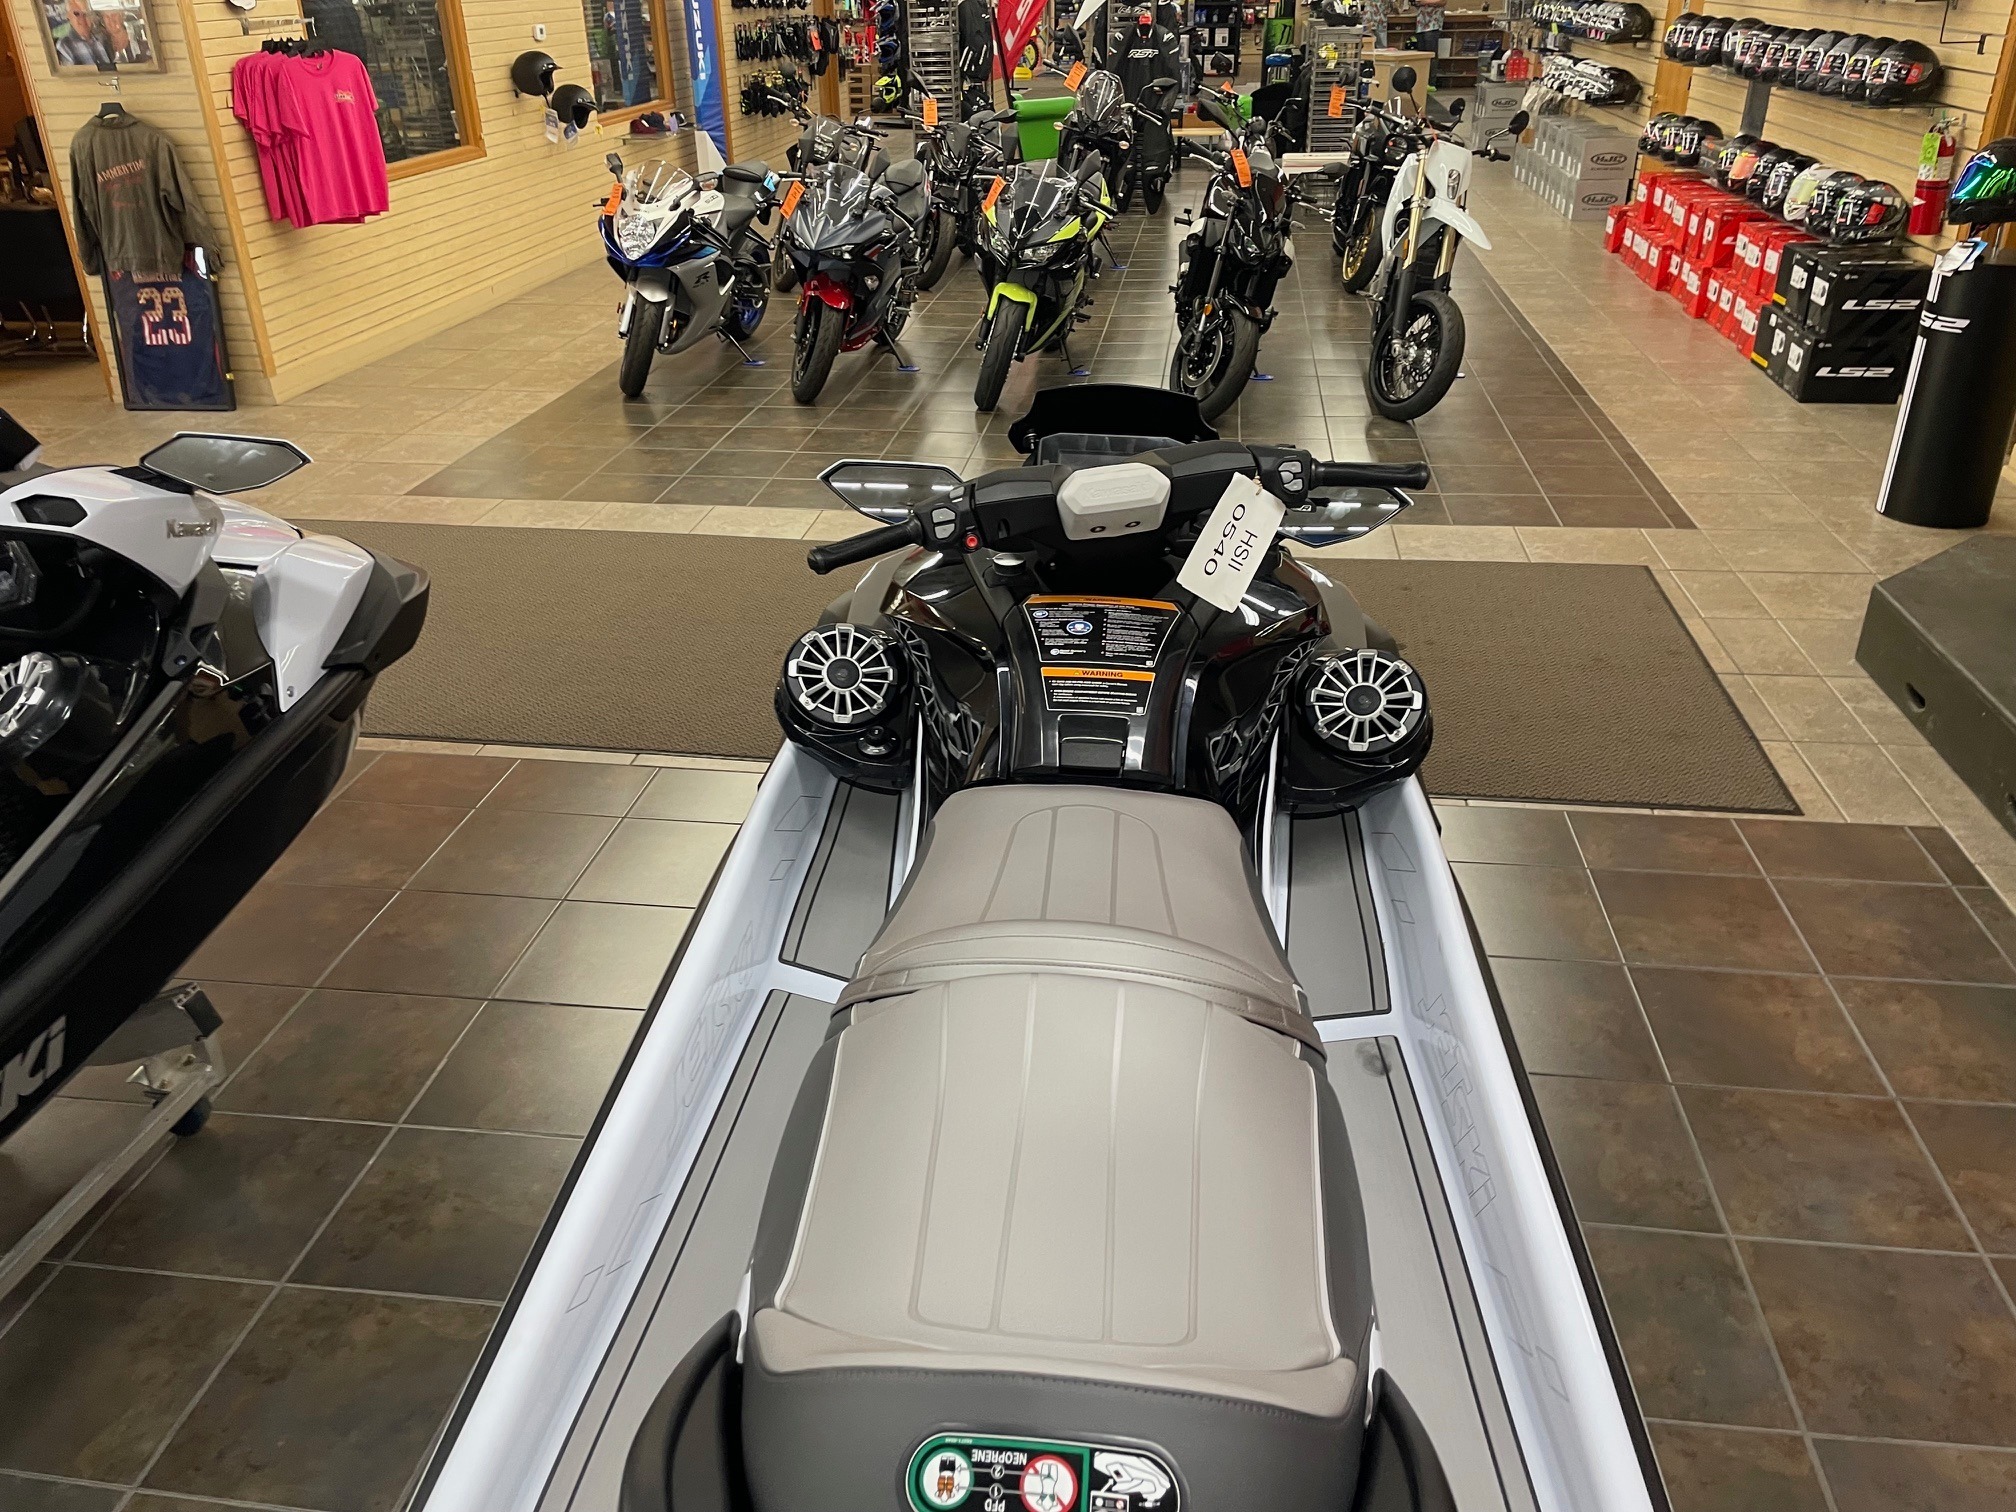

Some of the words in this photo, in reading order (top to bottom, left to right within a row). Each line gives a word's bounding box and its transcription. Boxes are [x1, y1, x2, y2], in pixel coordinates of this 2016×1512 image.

[1127, 49, 1159, 59] RST
[1841, 299, 1921, 310] LS2
[137, 287, 192, 345] 23
[1815, 367, 1895, 377] LS2
[1204, 504, 1246, 575] 0540
[1082, 670, 1123, 678] WARNING
[971, 1449, 1028, 1466] NEOPRENE
[984, 1498, 1006, 1512] PFD
